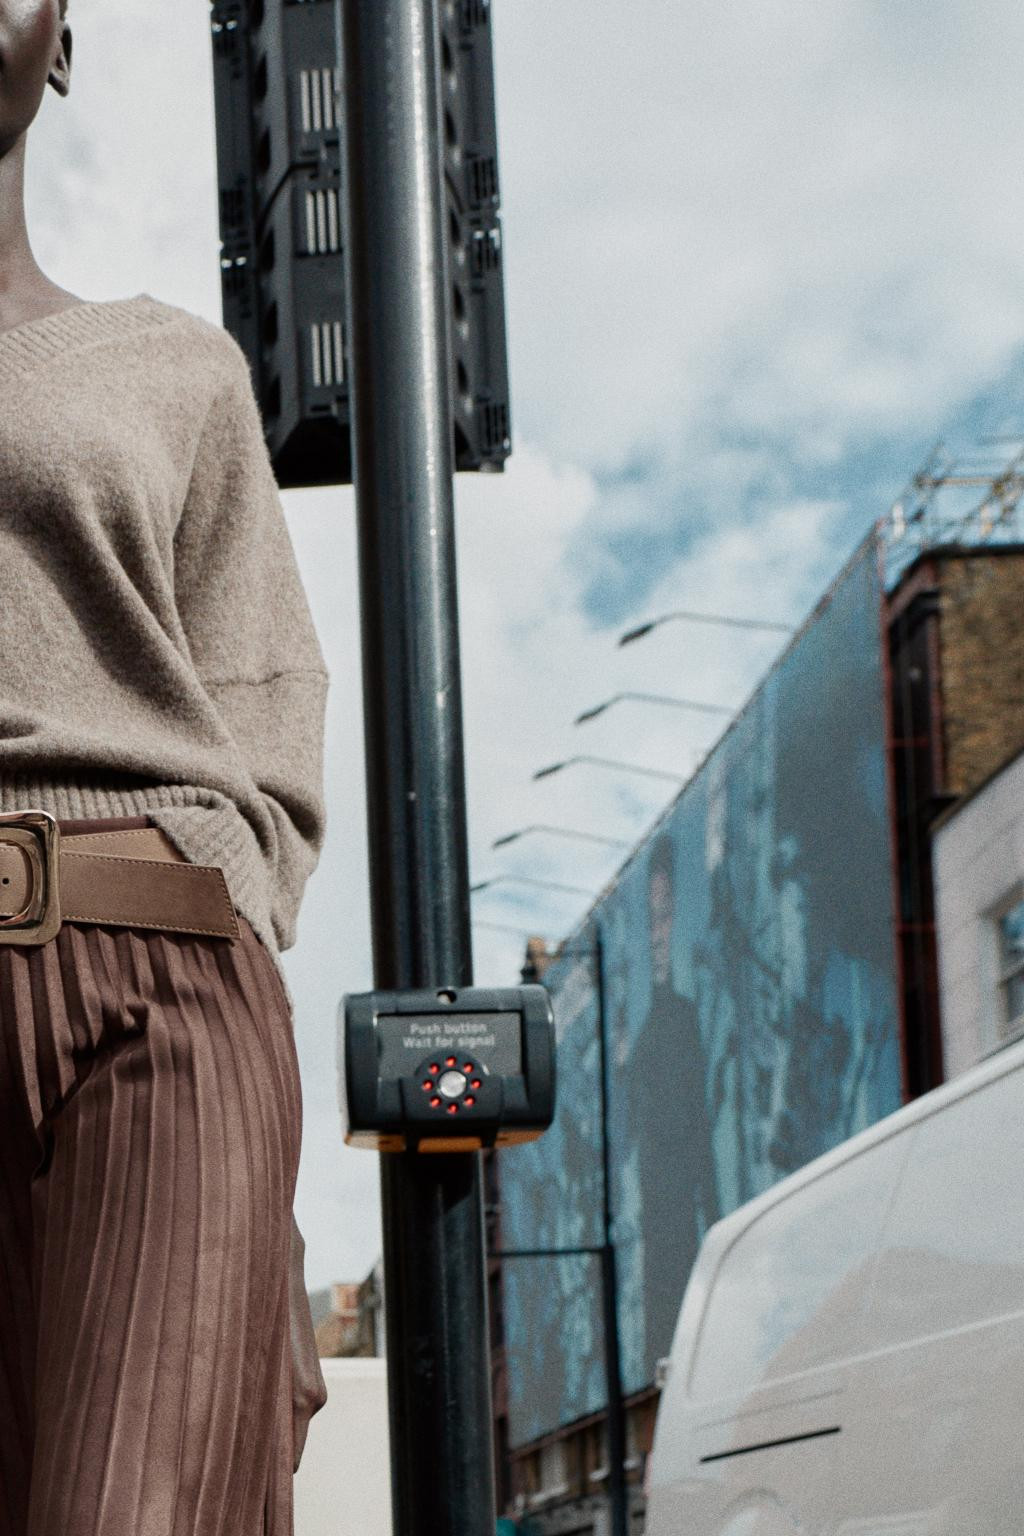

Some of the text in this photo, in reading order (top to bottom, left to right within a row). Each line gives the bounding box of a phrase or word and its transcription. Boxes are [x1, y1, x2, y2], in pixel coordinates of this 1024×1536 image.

[410, 1022, 488, 1035] Push button
[403, 1035, 495, 1049] Wait for signal
